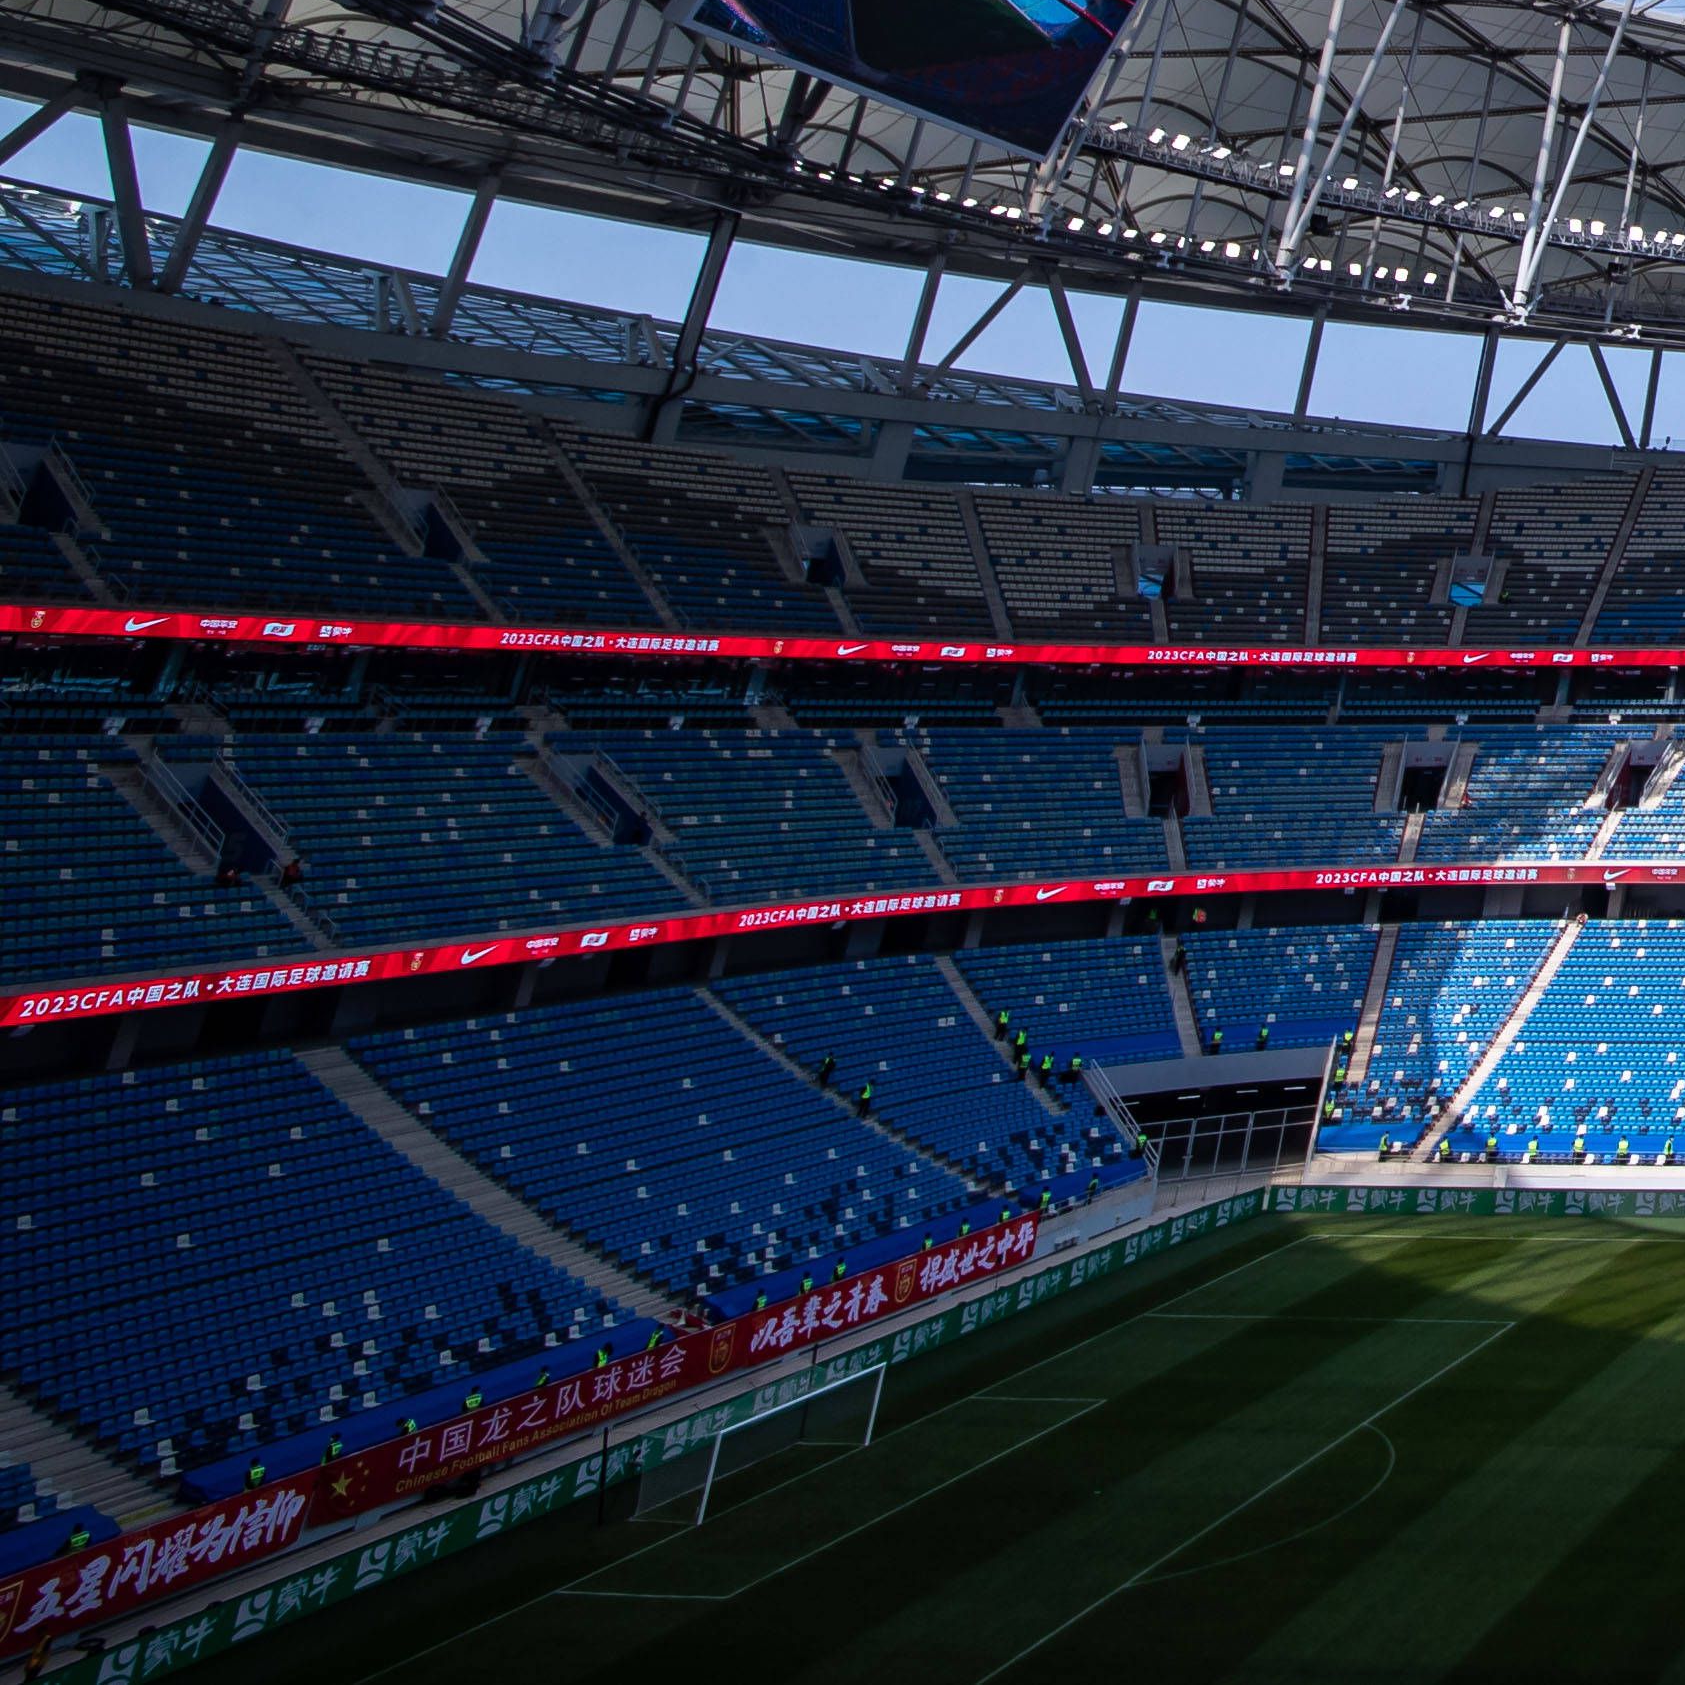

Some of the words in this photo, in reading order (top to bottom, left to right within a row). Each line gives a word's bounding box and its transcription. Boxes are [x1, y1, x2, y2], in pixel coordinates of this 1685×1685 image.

[738, 893, 962, 927] 2023CFA中国之队·大连国际足球邀请赛
[19, 960, 371, 1018] 2023CFA中国之队·大连国际足球邀请赛
[750, 1274, 889, 1353] 以吾辈之青春
[396, 1464, 449, 1494] Chinese
[451, 1443, 501, 1472] Football
[501, 1434, 530, 1457] Fans
[530, 1407, 599, 1443] Association
[614, 1391, 641, 1412] Team
[641, 1378, 677, 1404] Dragon
[397, 1343, 687, 1475] 中国龙之队球迷会
[511, 1474, 565, 1523] 蒙牛
[13, 1488, 307, 1634] 五星闪耀为信仰
[393, 1519, 453, 1572] 蒙牛
[275, 1565, 342, 1621] 蒙牛
[142, 1616, 219, 1677] 蒙牛
